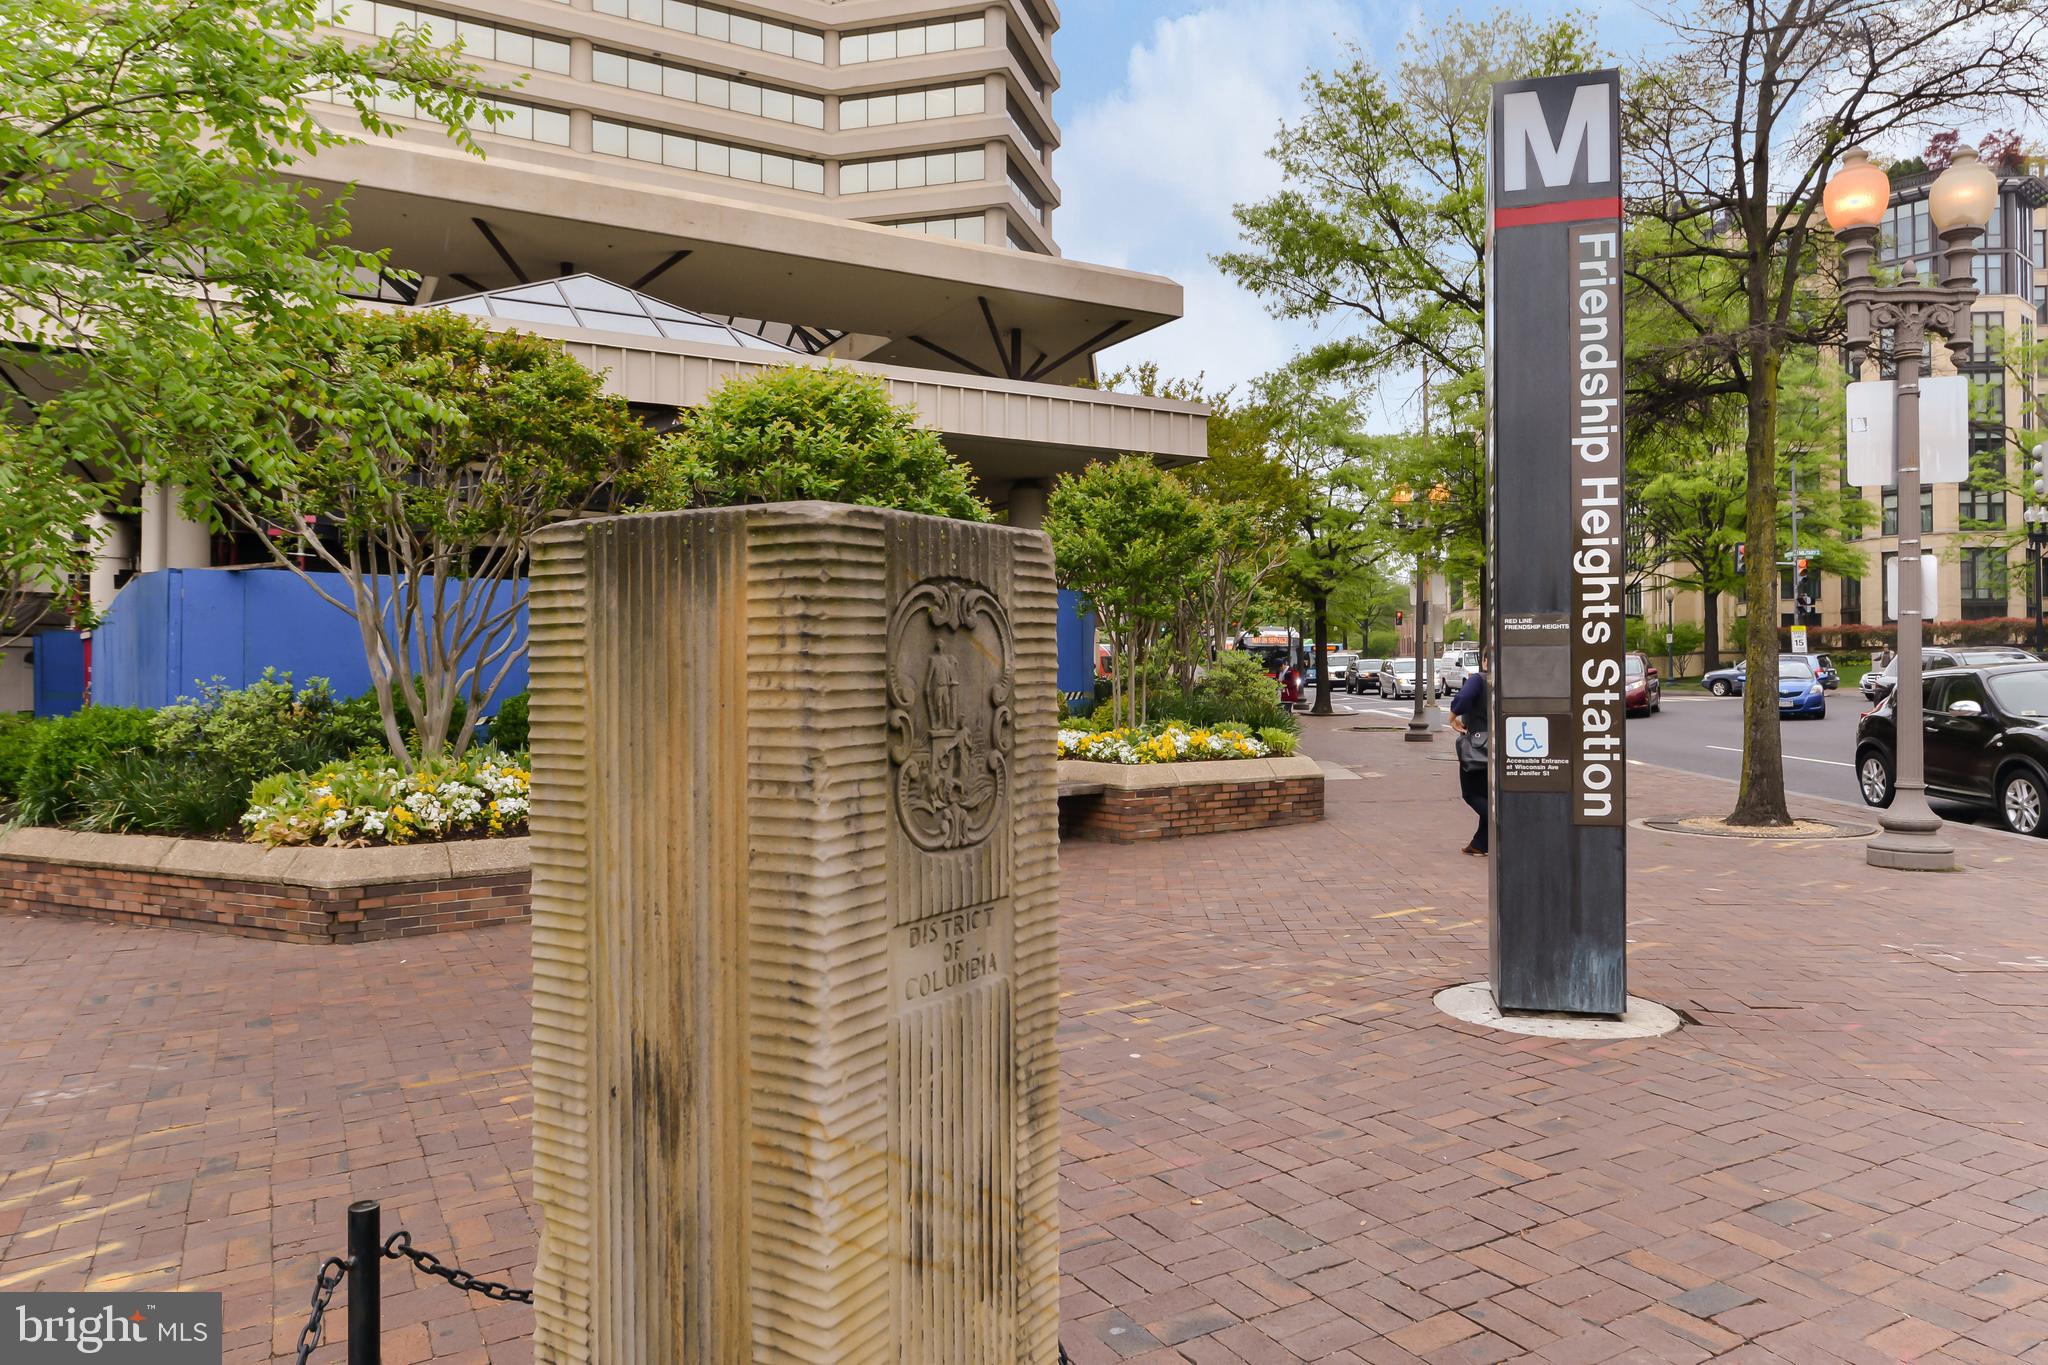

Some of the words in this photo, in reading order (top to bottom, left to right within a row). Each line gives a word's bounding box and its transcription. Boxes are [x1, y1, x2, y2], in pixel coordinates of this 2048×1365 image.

[1504, 83, 1610, 192] M
[1571, 232, 1618, 463] Friendship
[1573, 477, 1620, 645] Heights
[1794, 639, 1805, 647] 15
[1582, 658, 1621, 817] Station
[909, 906, 995, 949] DISTRICT
[943, 939, 964, 963] OF
[905, 951, 998, 1001] COLUMBIA
